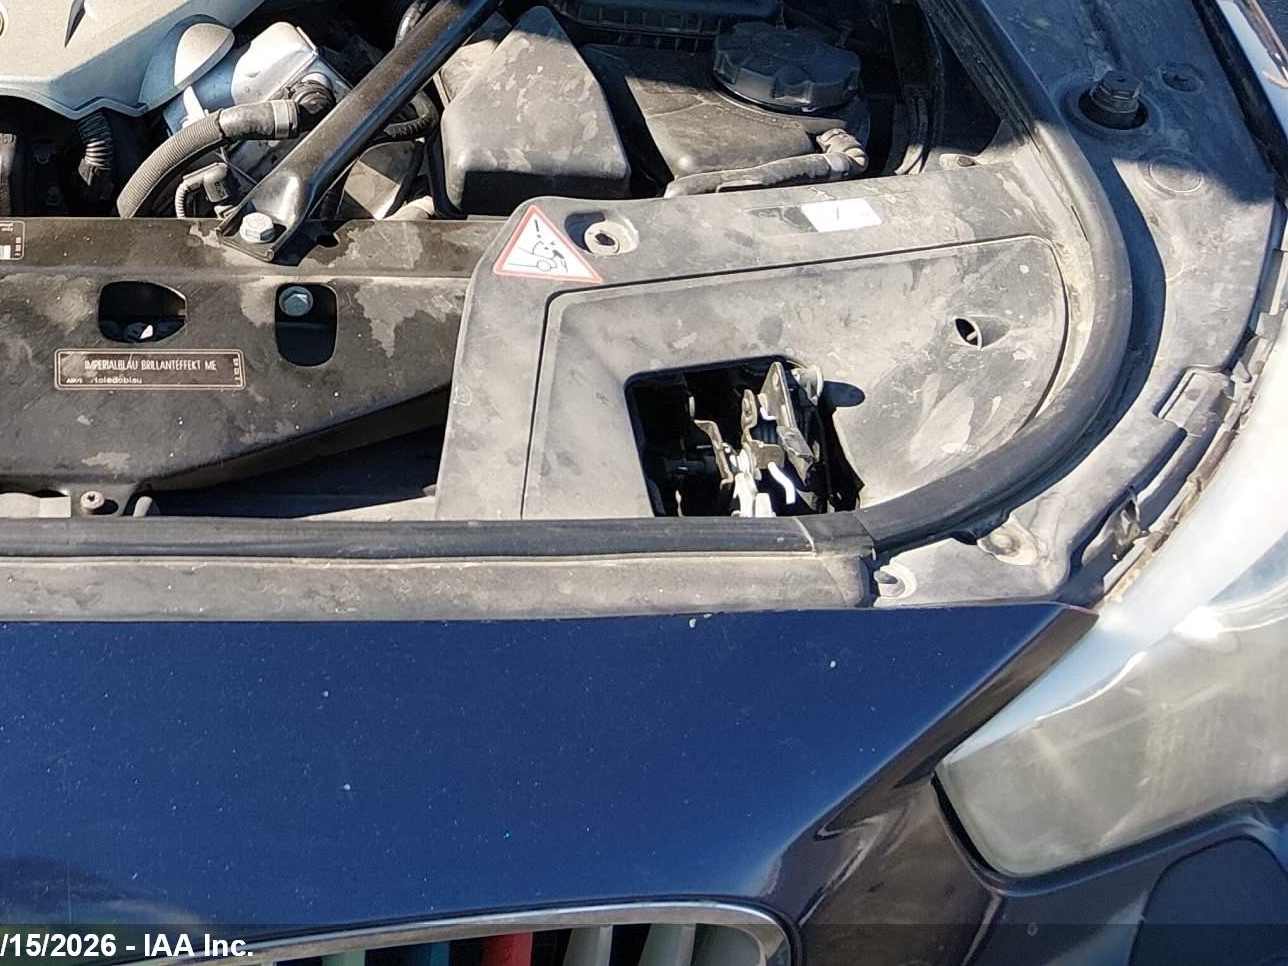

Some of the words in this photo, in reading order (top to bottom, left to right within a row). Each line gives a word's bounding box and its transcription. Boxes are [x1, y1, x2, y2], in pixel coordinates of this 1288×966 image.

[84, 359, 138, 371] IMPERIALBLAU
[141, 359, 201, 371] BRILLANTEFFEKT
[204, 359, 217, 371] ME
